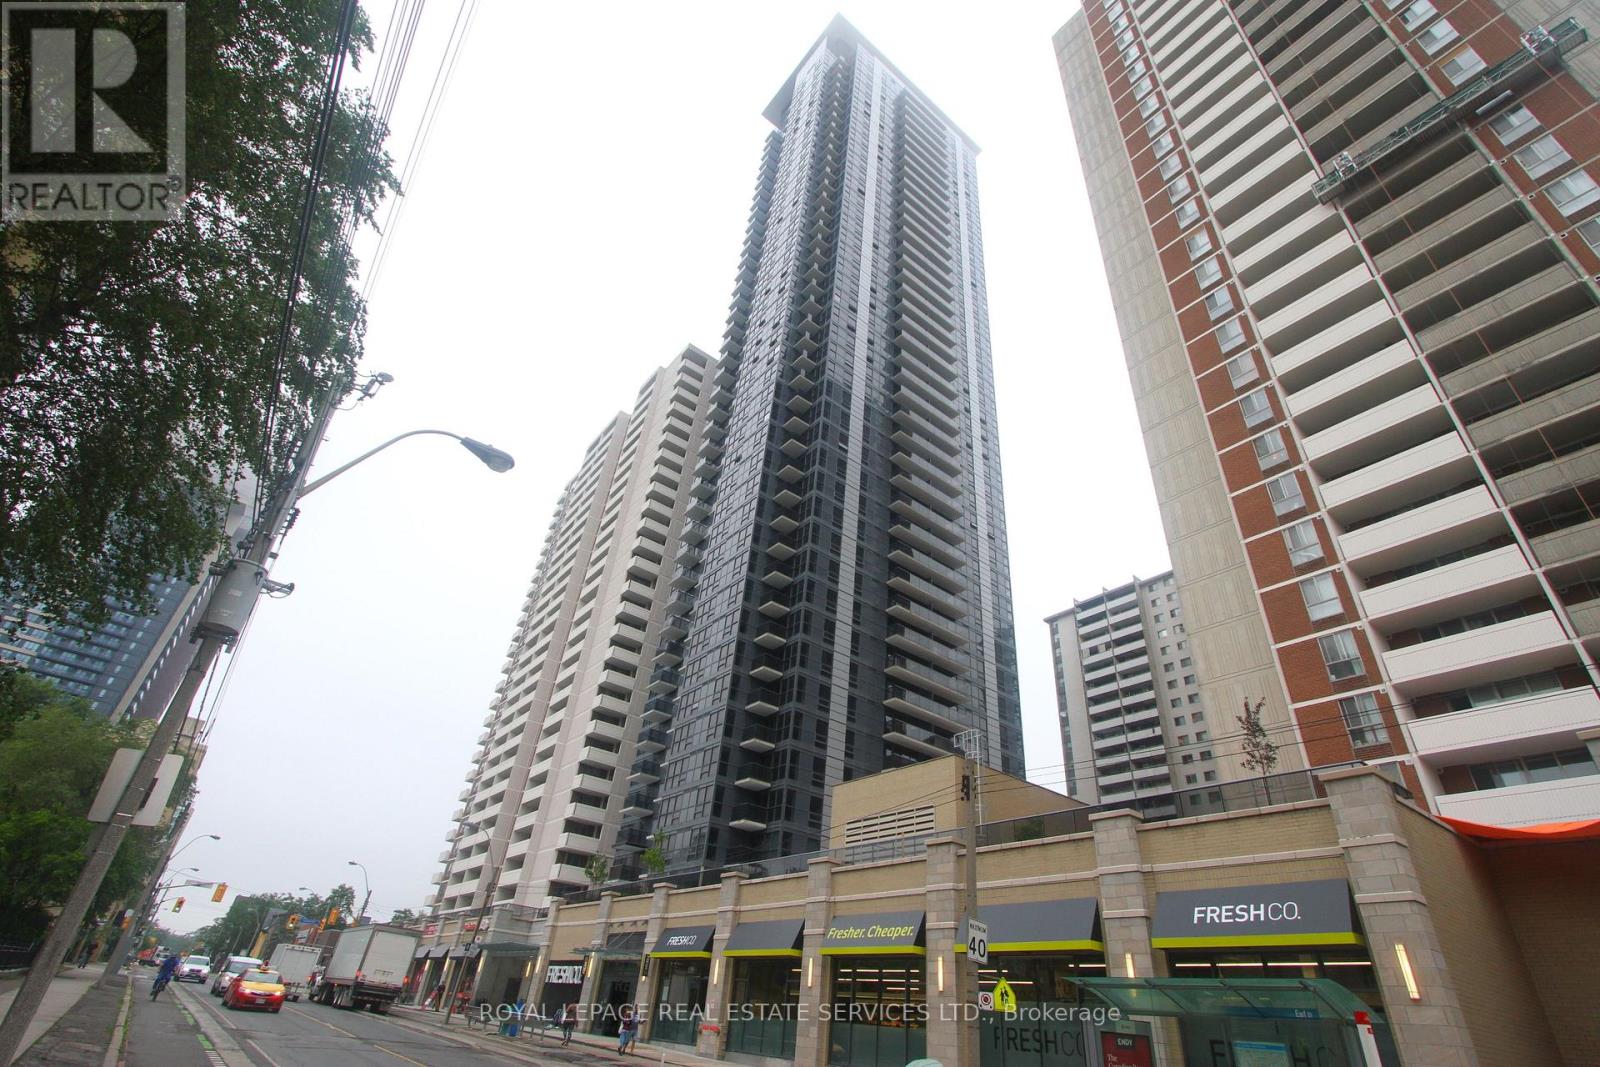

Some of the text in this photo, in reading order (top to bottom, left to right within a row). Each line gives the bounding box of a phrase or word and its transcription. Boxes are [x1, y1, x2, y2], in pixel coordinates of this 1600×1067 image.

[827, 925, 914, 940] Fresher. Cheaper.
[969, 936, 986, 958] 40
